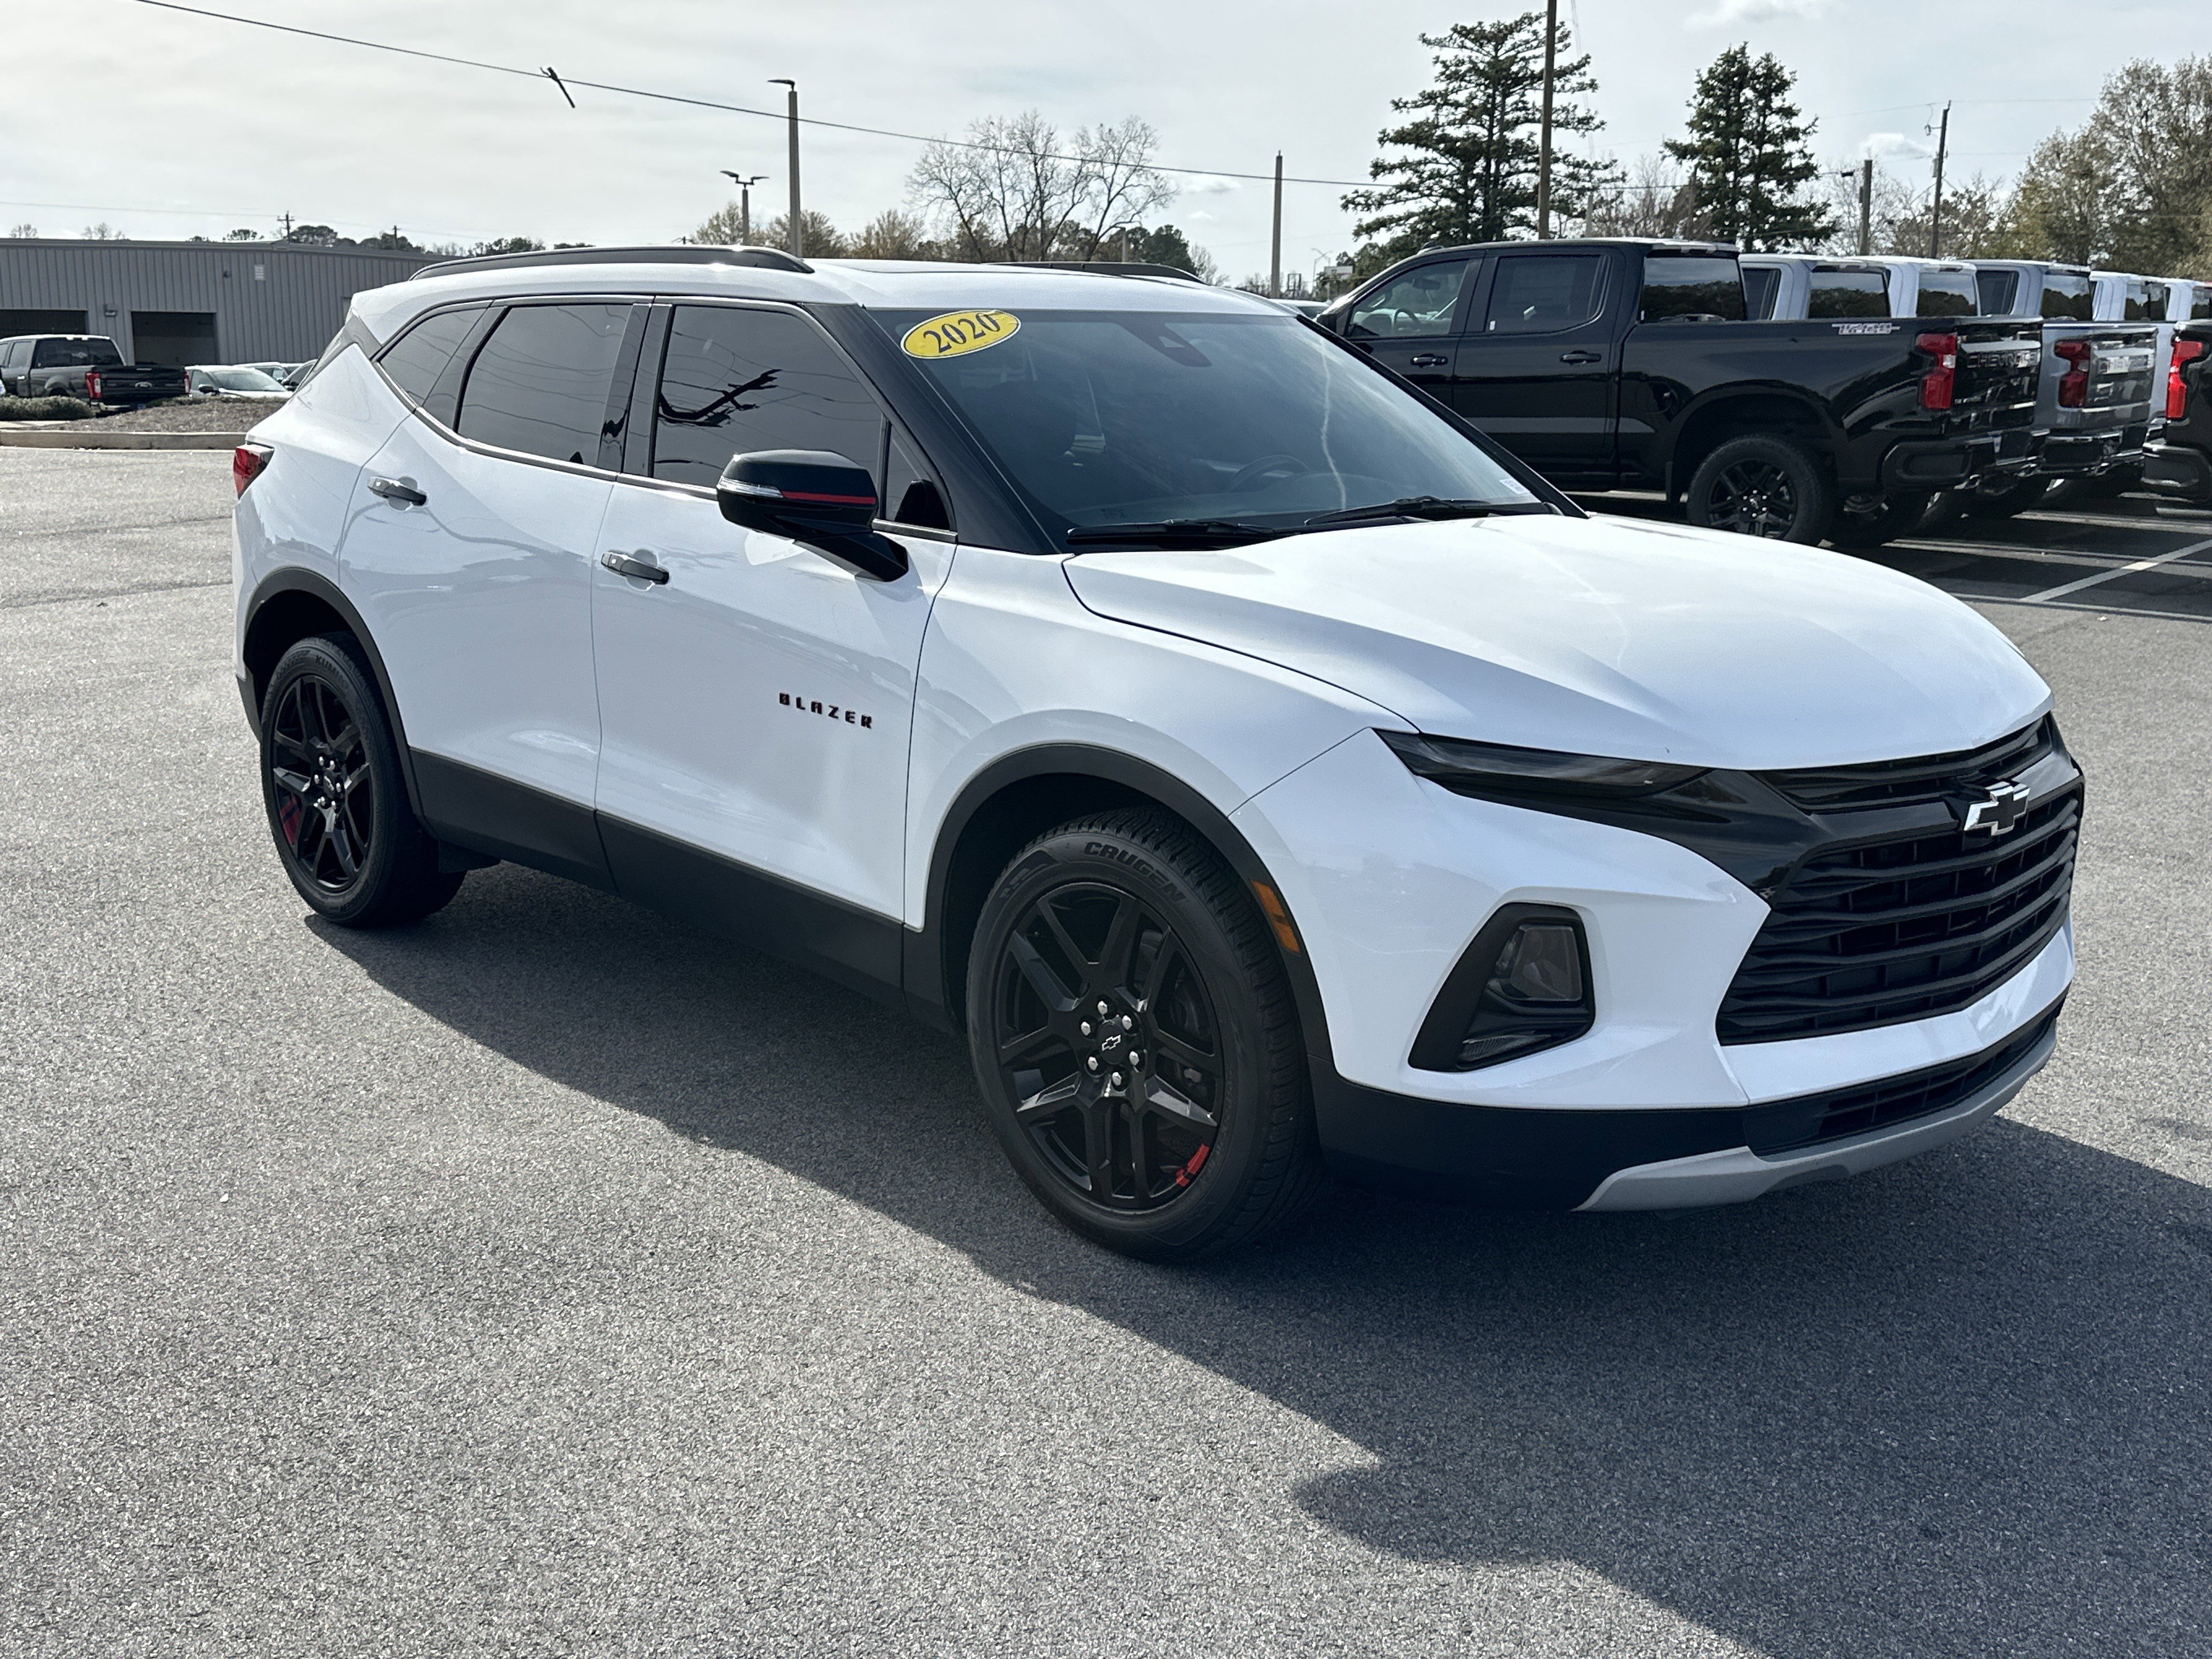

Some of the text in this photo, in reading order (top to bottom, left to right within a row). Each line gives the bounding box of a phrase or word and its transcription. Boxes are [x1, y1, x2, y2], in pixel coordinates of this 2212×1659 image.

[923, 313, 1000, 353] 2020
[779, 692, 872, 729] BLAZER
[1084, 842, 1186, 902] CRUGEN
